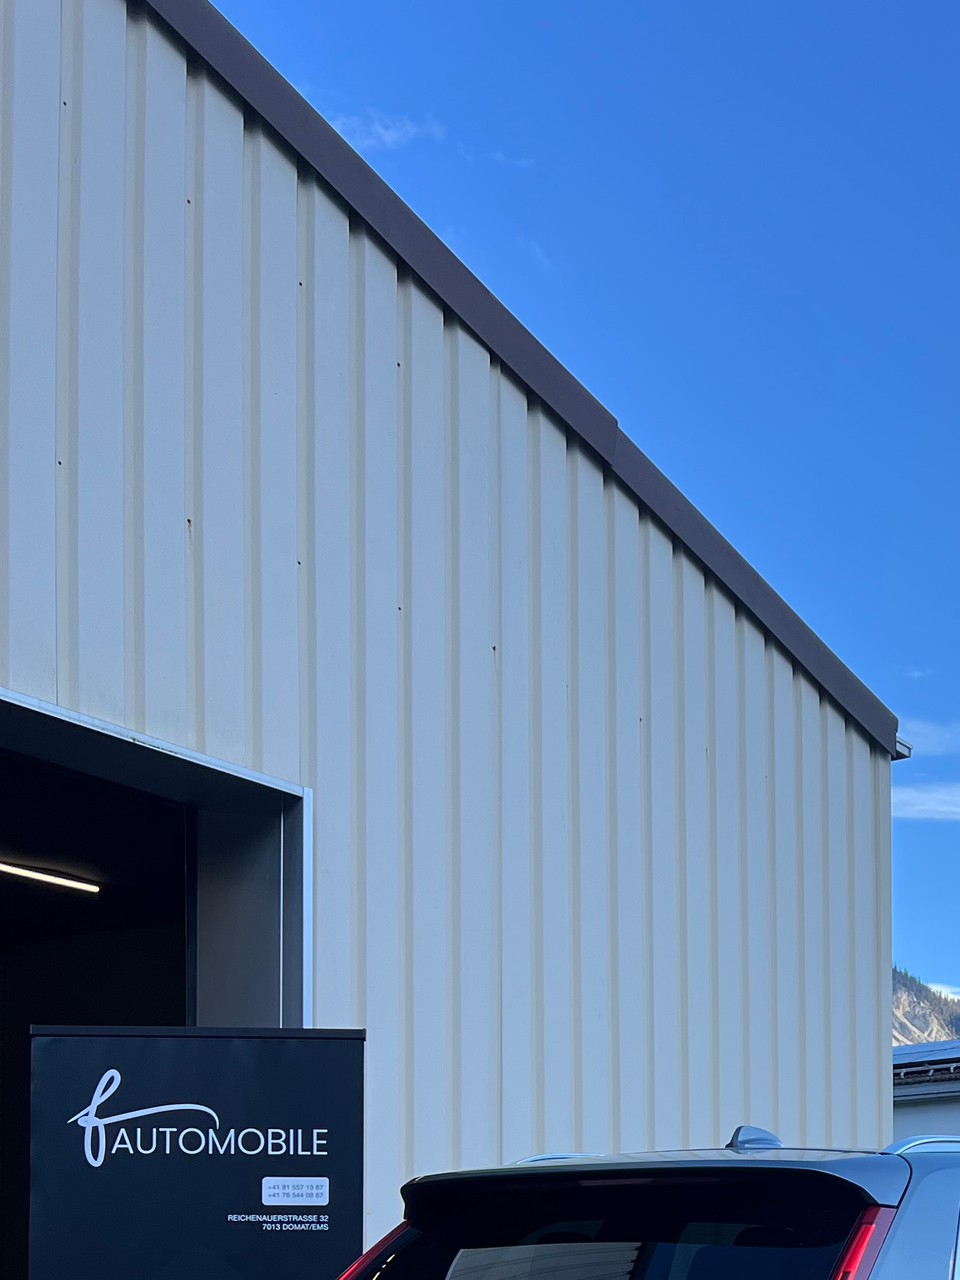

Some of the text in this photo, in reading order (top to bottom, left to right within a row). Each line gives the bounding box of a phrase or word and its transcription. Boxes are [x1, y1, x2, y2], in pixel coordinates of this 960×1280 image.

[111, 1127, 329, 1155] AUTOMOBILE
[227, 1214, 329, 1222] REICHENAUERSTRASSE 32
[262, 1223, 329, 1231] 7013 DOMAT/EMS
